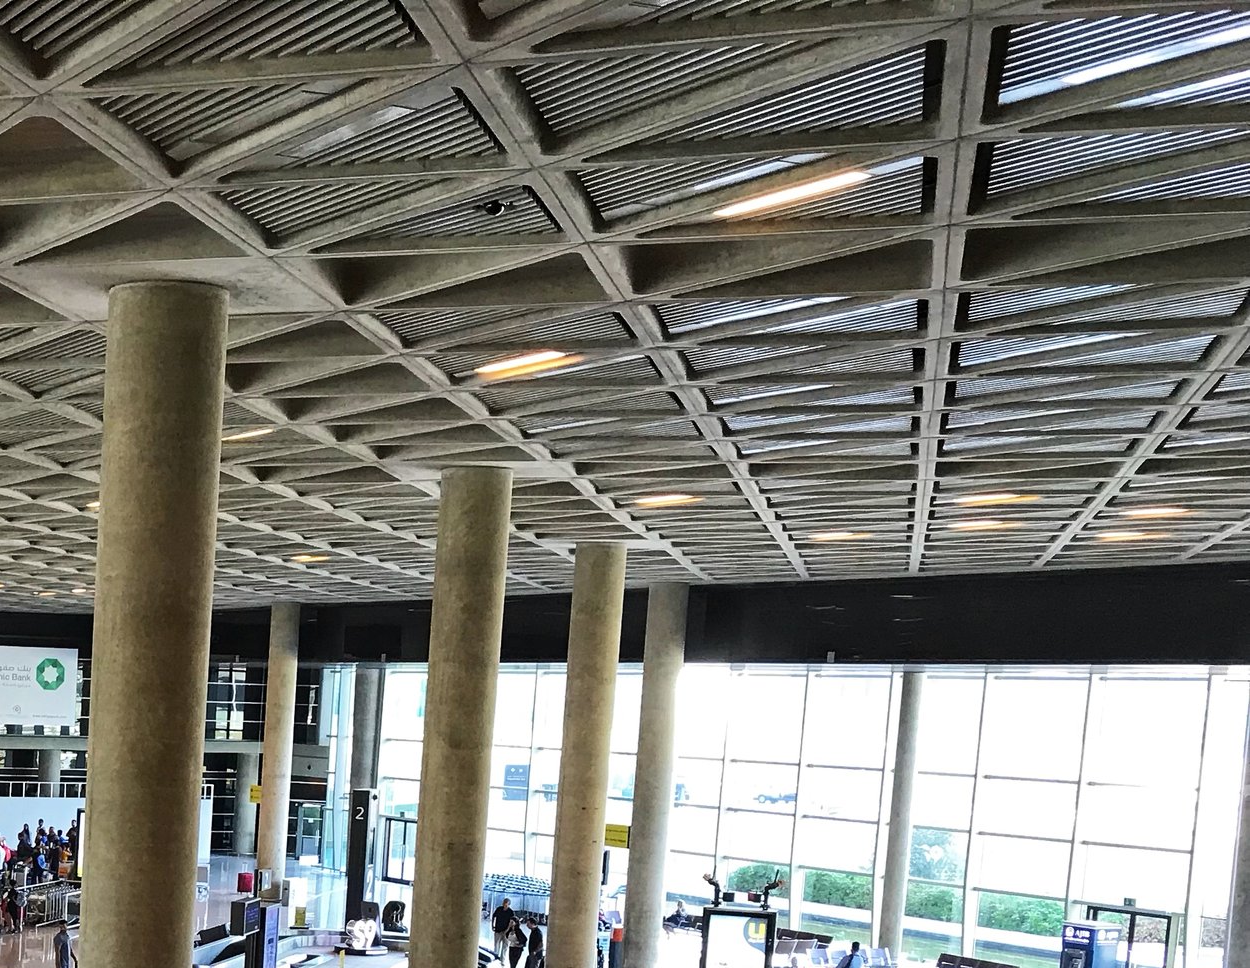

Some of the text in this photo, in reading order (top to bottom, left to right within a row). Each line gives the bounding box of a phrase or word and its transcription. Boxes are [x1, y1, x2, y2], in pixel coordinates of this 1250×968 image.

[17, 664, 32, 672] بنك
[11, 673, 31, 681] Bank
[355, 806, 365, 820] 2
[347, 919, 377, 950] S9
